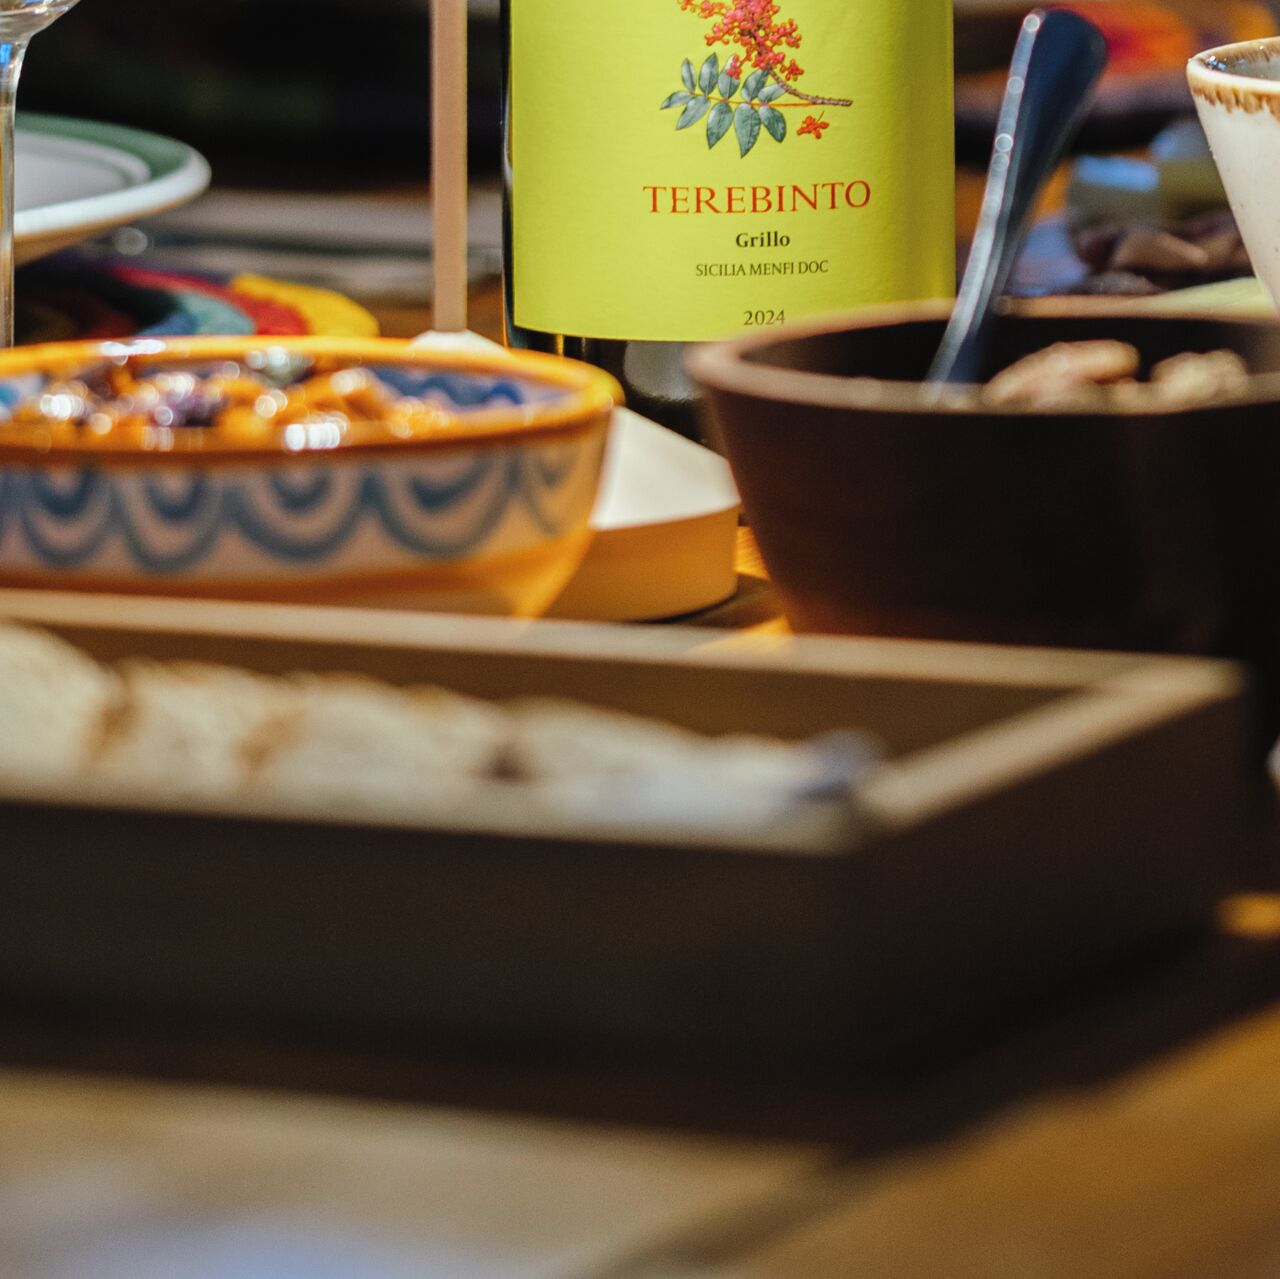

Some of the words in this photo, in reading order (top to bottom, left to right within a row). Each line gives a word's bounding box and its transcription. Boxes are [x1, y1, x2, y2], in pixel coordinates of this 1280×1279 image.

[642, 180, 871, 214] TEREBINTO
[736, 231, 790, 248] Grillo
[696, 263, 746, 277] SICILIA
[749, 262, 794, 276] MENFI
[798, 260, 829, 275] DOC
[743, 310, 786, 326] 2024
